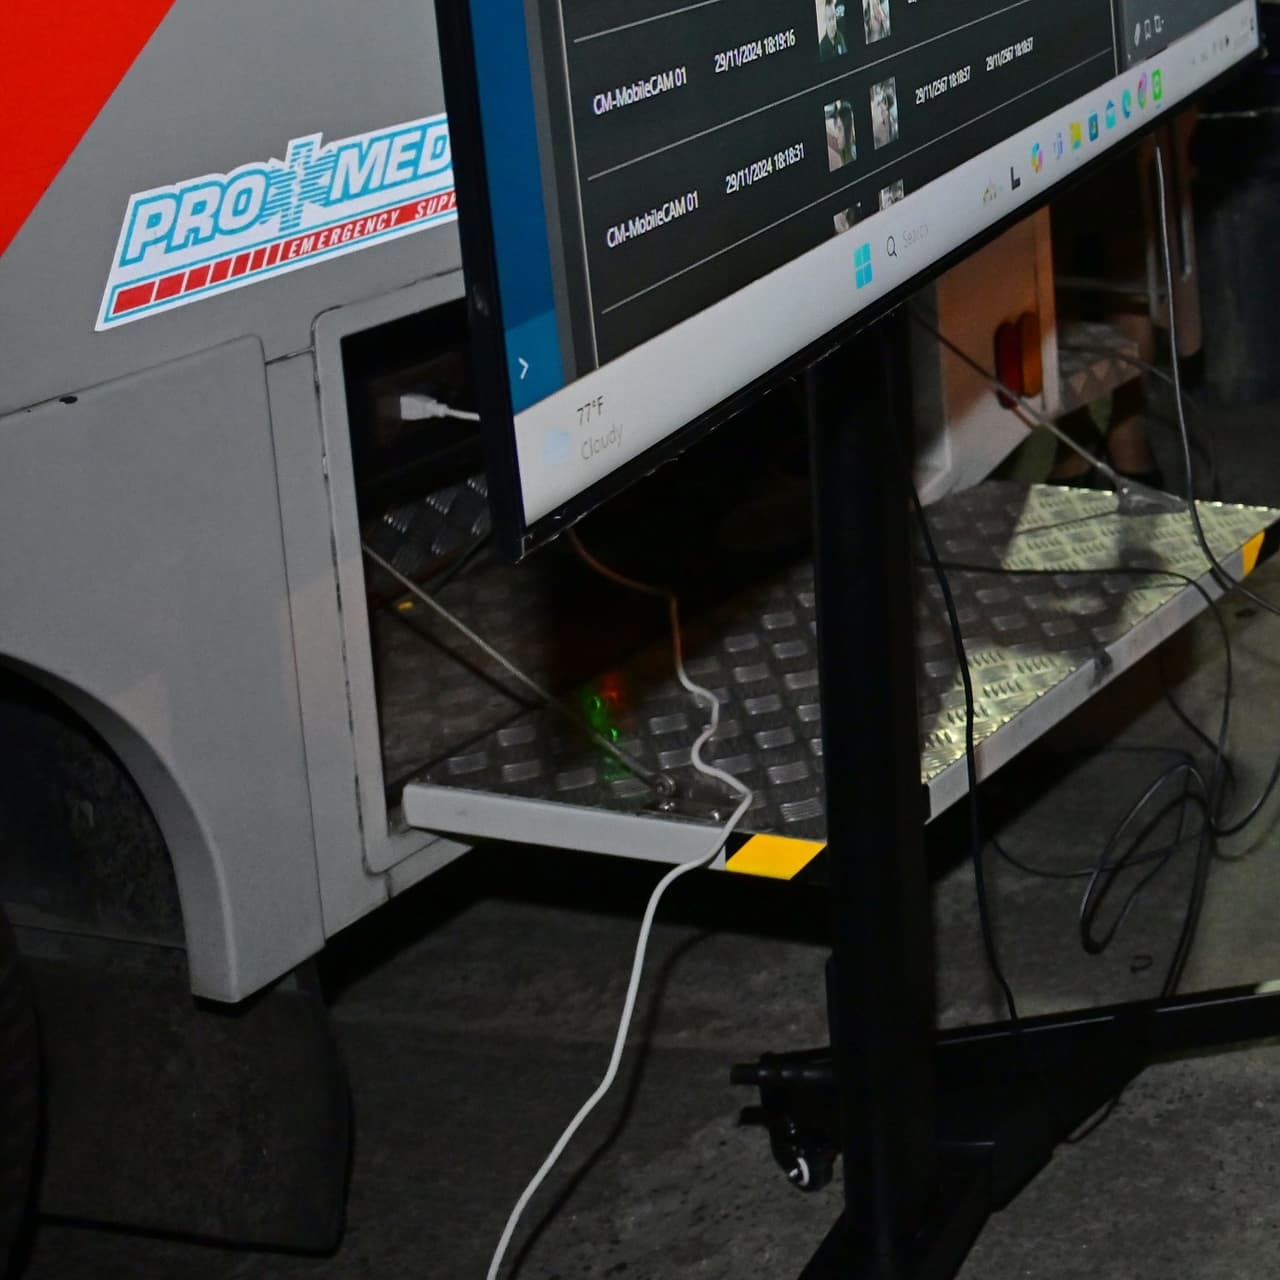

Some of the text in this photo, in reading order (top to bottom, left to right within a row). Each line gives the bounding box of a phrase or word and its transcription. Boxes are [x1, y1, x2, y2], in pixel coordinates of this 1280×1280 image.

[714, 41, 762, 73] 29/11/2024
[593, 66, 688, 116] CM-MobileCAM 01
[725, 157, 773, 195] 29/11/2024
[124, 169, 269, 264] PRO
[288, 210, 400, 258] EMERGENCY
[607, 191, 700, 249] CM-MobileCAM 01
[576, 395, 604, 426] 77°F
[580, 424, 623, 461] Cloudy
